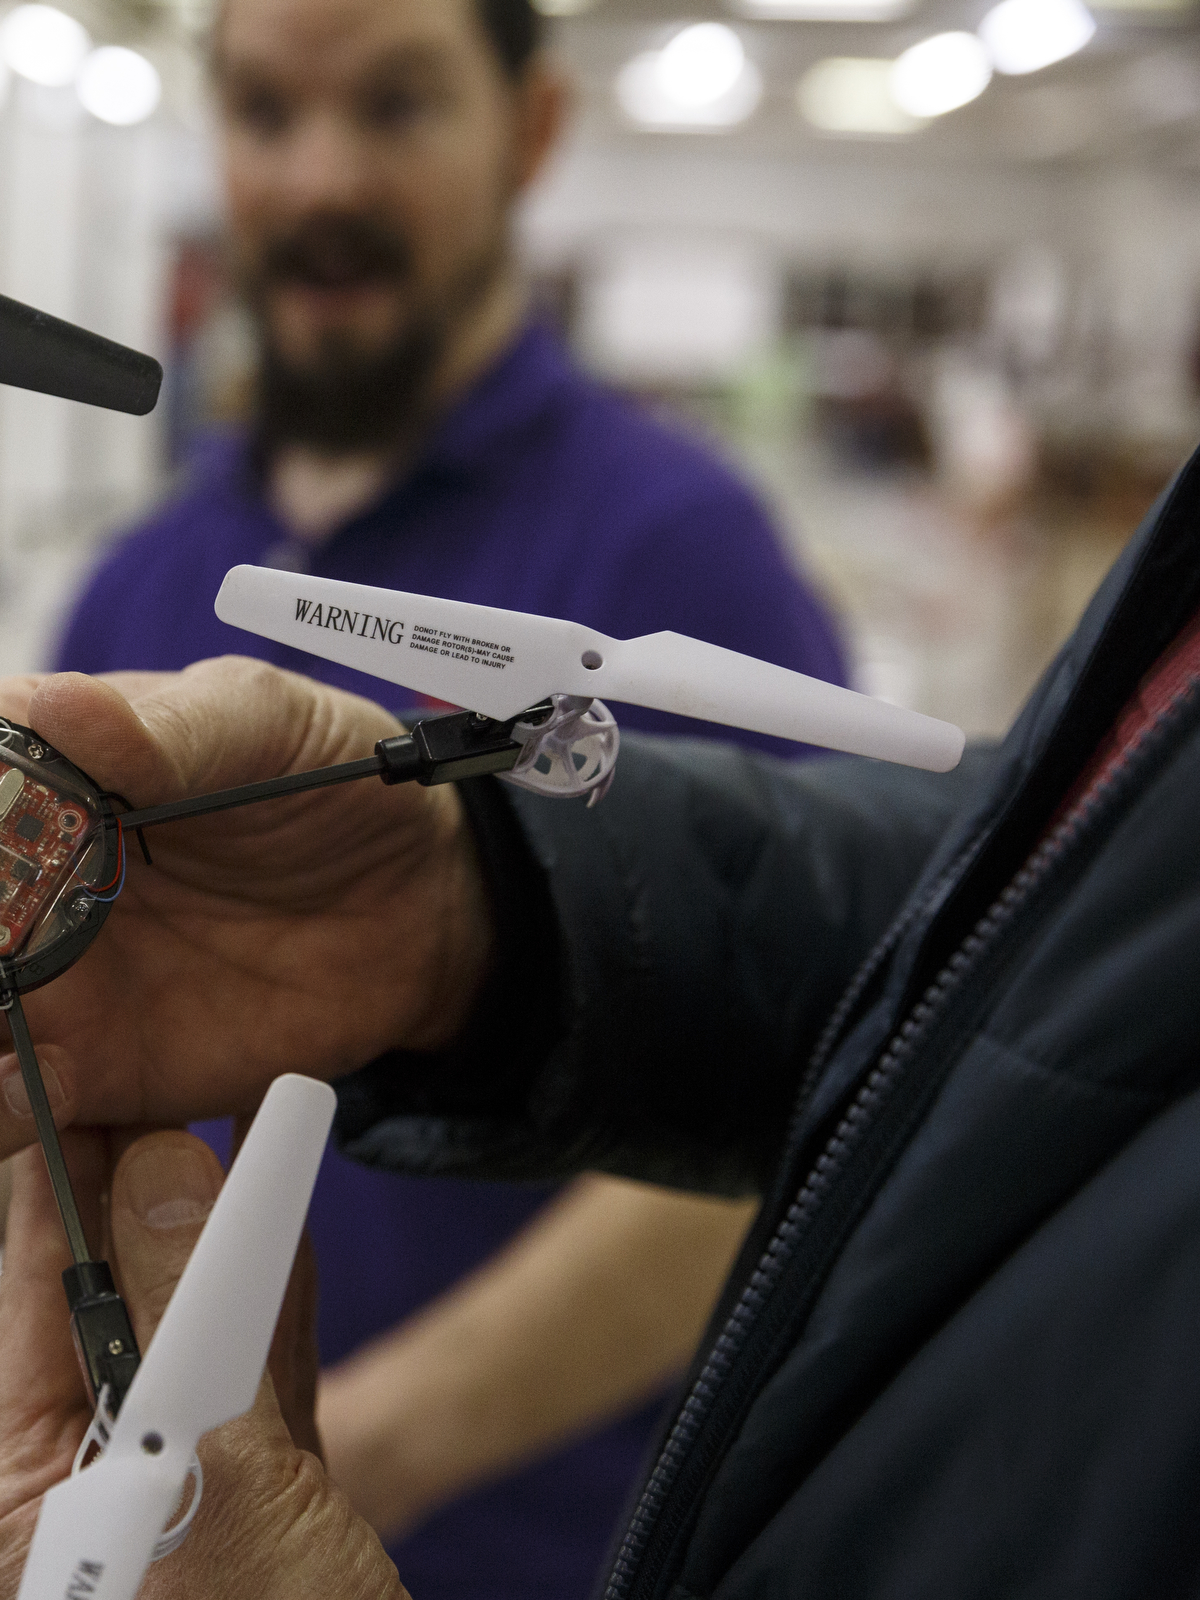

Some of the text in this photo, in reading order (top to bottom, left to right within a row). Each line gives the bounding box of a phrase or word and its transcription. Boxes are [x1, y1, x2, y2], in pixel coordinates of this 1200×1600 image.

[295, 598, 405, 645] WARNING
[411, 633, 515, 663] DAMAGE ROTOR(S)-MAY CAUSE
[413, 625, 511, 653] DONOT FLY WITH BROKEN OR
[409, 641, 439, 654] DAMAGE
[451, 651, 470, 661] LEAD
[471, 656, 480, 664] TO
[481, 658, 506, 670] INJURY
